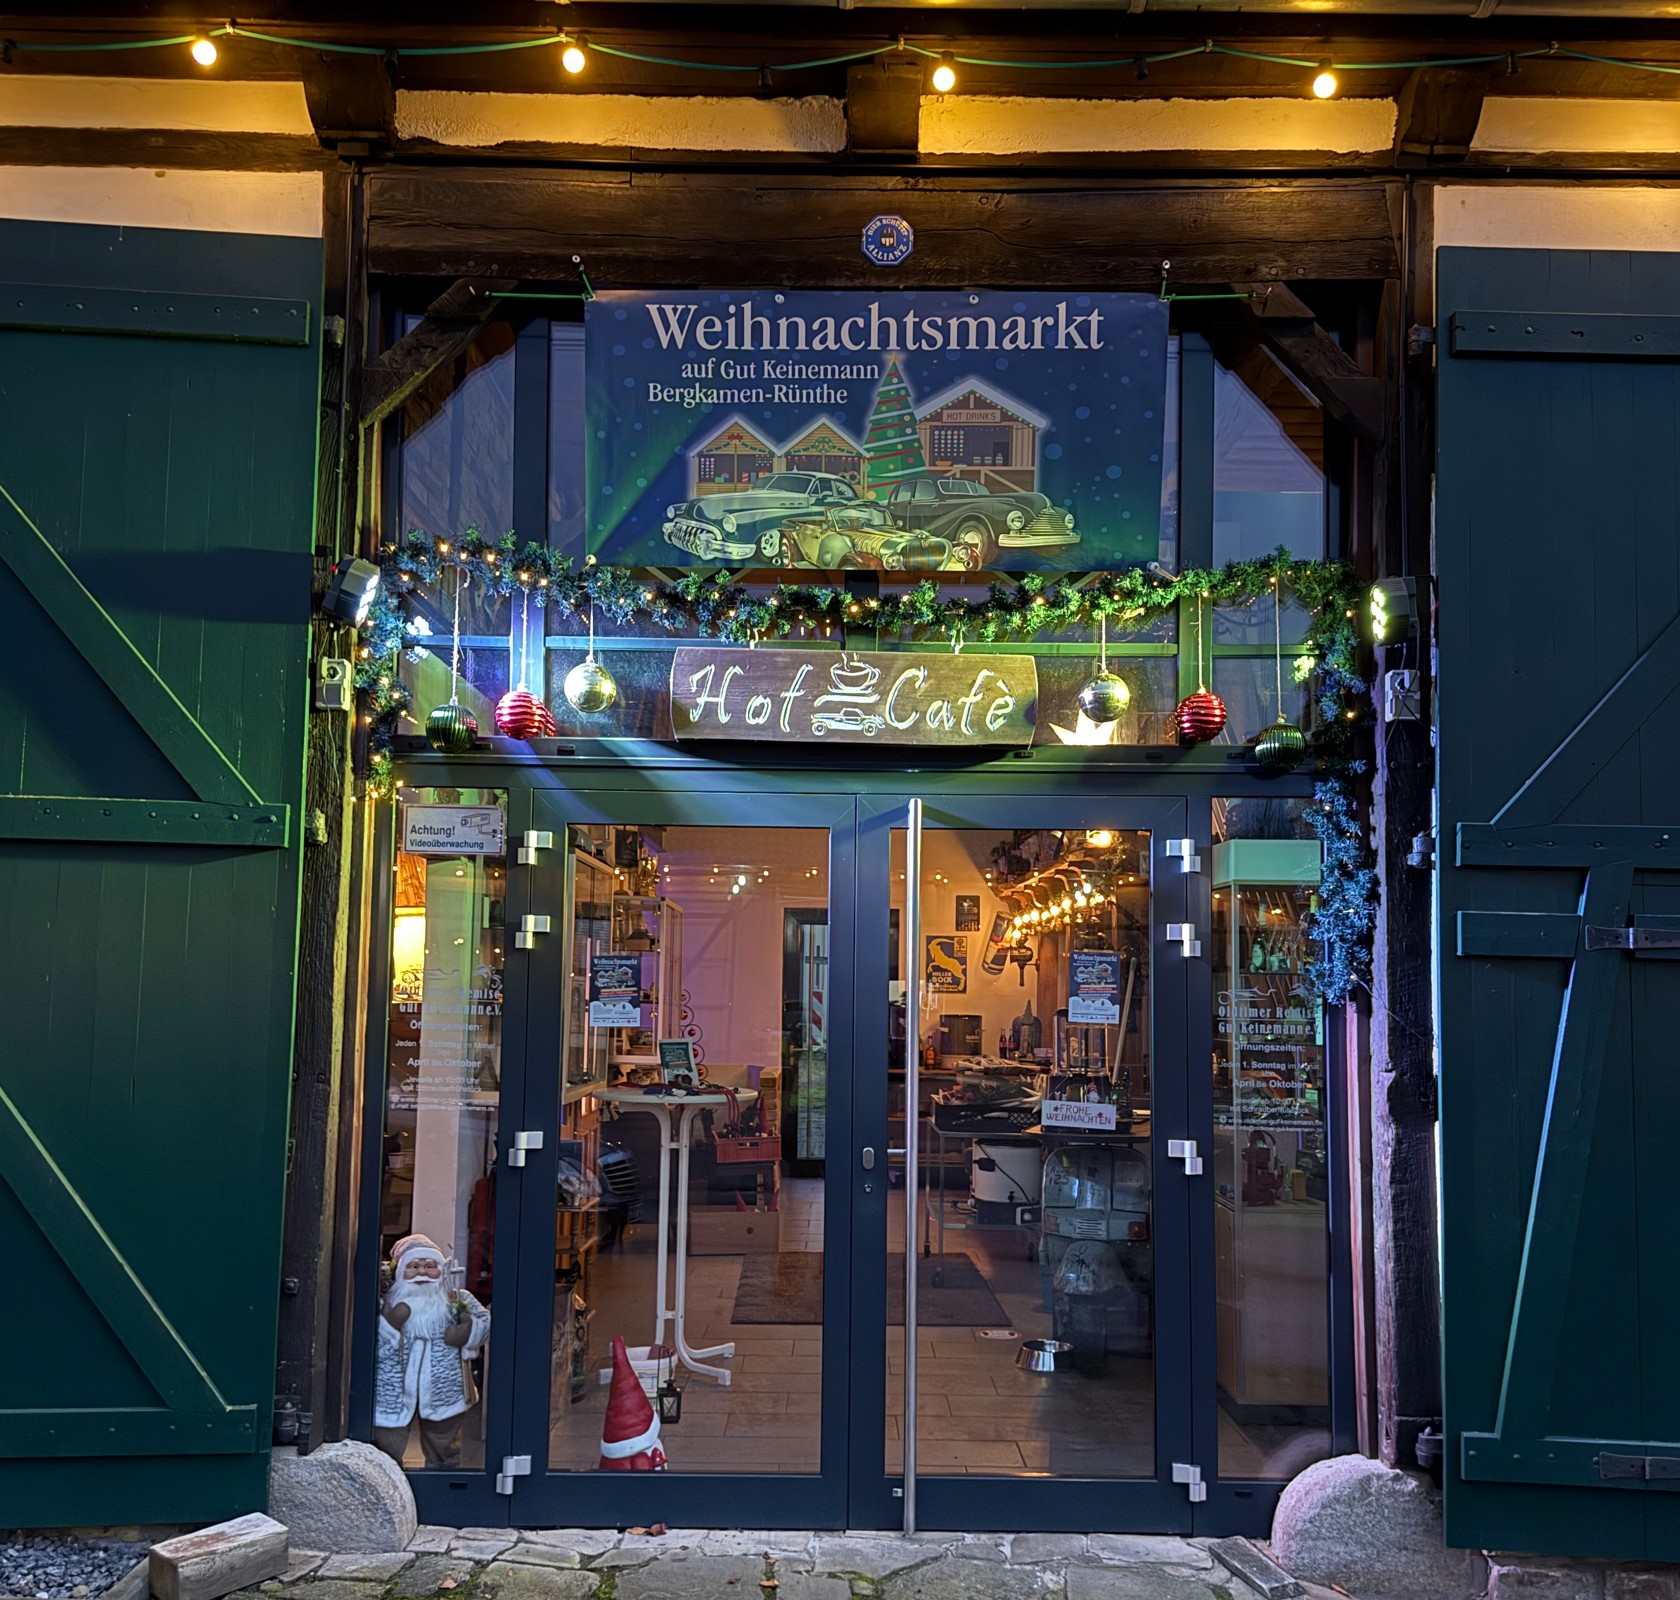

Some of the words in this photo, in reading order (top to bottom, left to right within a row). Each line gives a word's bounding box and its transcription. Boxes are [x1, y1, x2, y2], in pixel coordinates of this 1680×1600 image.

[867, 245, 908, 261] ALLIANZ
[646, 300, 1105, 351] Weihnachtsmarkt
[682, 358, 716, 379] auf
[720, 360, 757, 379] Gut
[763, 360, 880, 380] Keinemann
[648, 383, 848, 408] Bergkamen-Rünthe
[410, 825, 456, 838] Achtung!
[409, 840, 484, 850] Videoüberwachung
[1252, 1061, 1287, 1071] Sonntag
